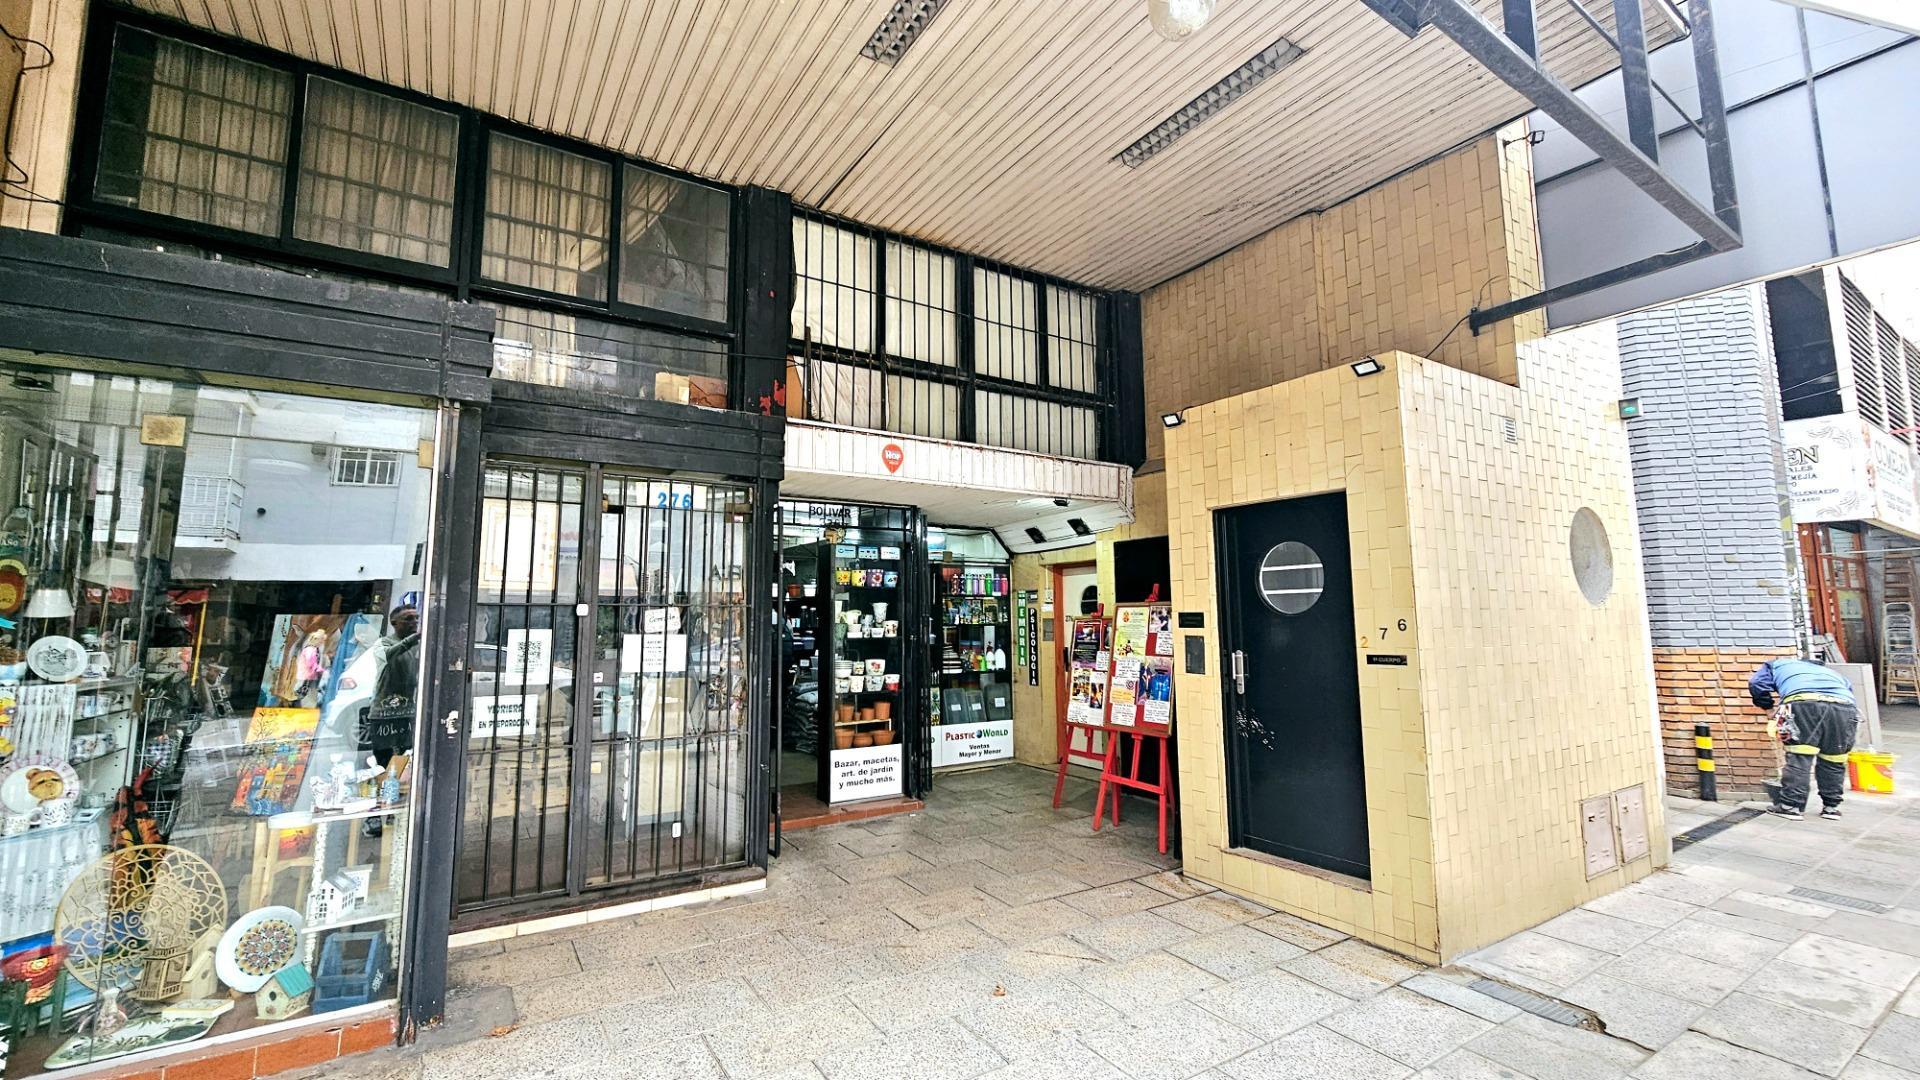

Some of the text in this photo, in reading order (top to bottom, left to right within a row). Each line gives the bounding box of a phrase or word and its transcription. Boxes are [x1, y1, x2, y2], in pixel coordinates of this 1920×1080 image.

[657, 491, 692, 509] 276
[809, 506, 851, 518] BOLIVAR
[478, 720, 487, 729] EN
[945, 731, 976, 742] PLASTIC
[982, 728, 1009, 738] WORLD
[958, 751, 977, 759] Mayor
[834, 755, 900, 769] Bazar, macetas,
[841, 770, 856, 778] art.
[857, 768, 868, 776] de
[838, 781, 844, 789] y
[846, 777, 874, 787] mucho
